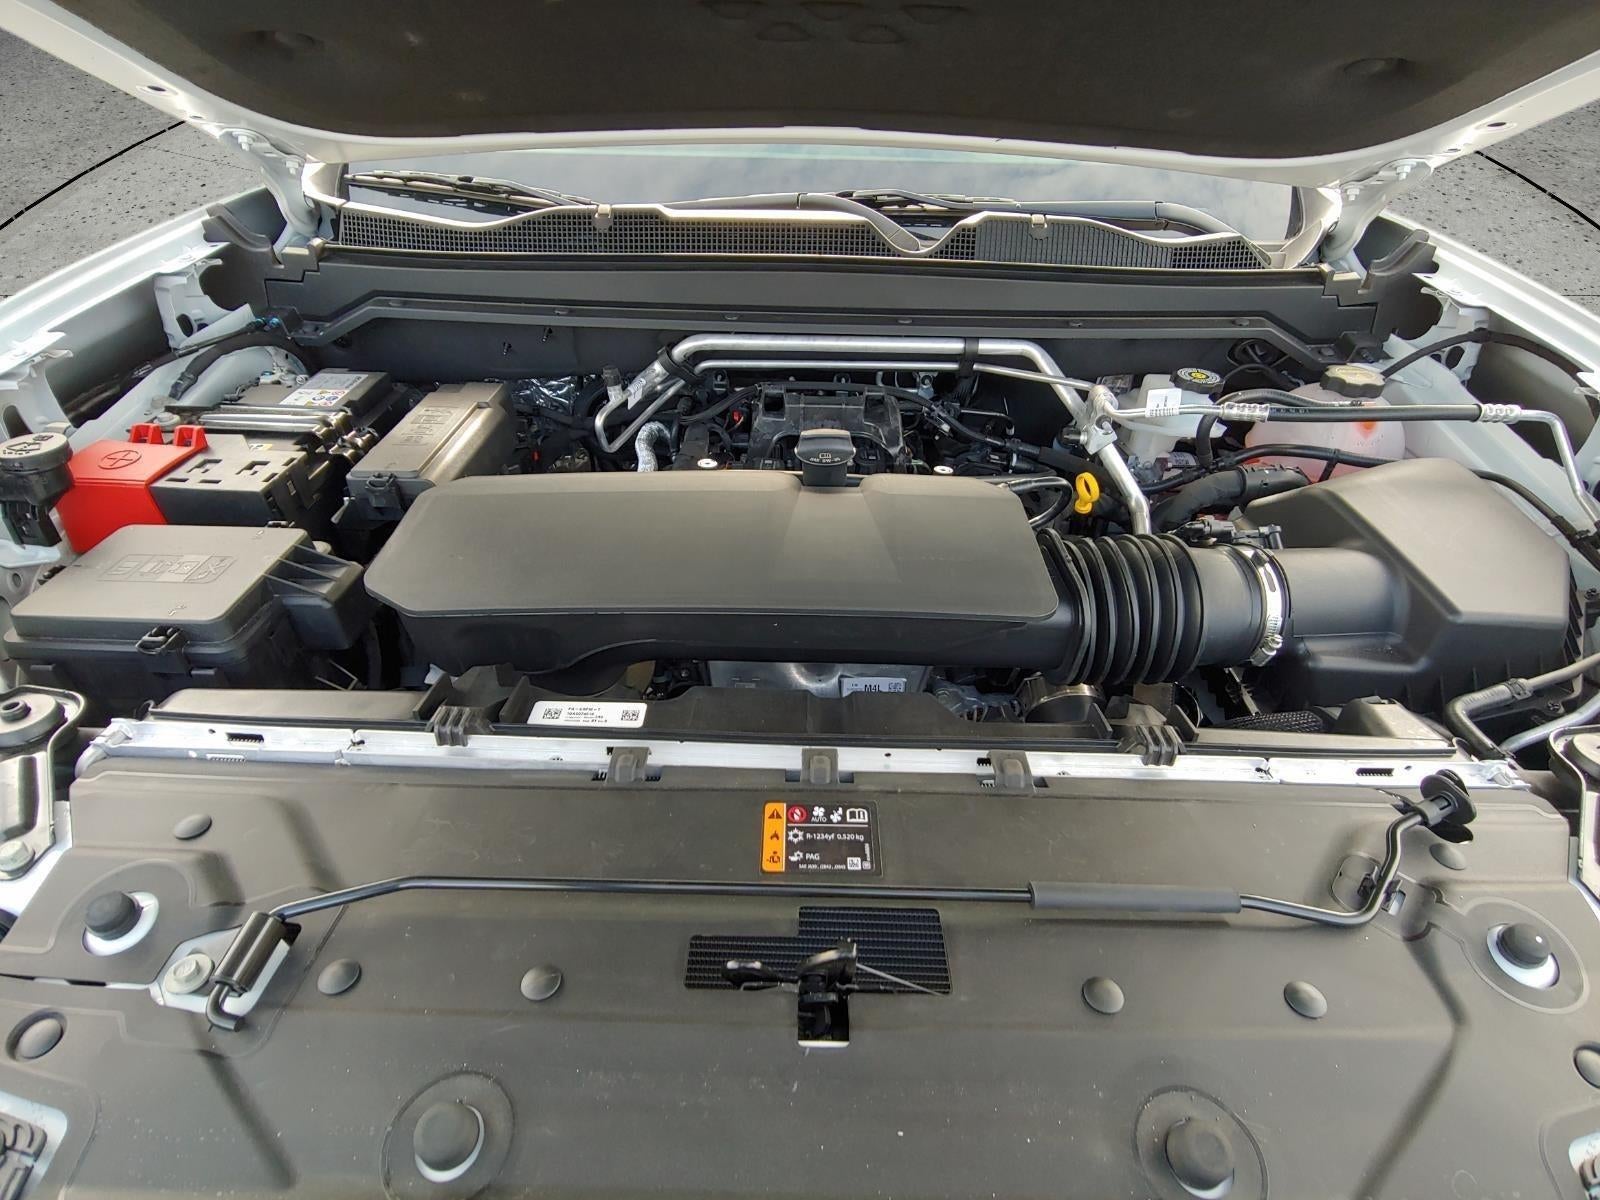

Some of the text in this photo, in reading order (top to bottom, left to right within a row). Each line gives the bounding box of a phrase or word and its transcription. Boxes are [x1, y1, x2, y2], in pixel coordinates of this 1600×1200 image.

[806, 833, 835, 841] R-1234yf
[856, 833, 864, 841] kg
[805, 853, 820, 861] PAG
